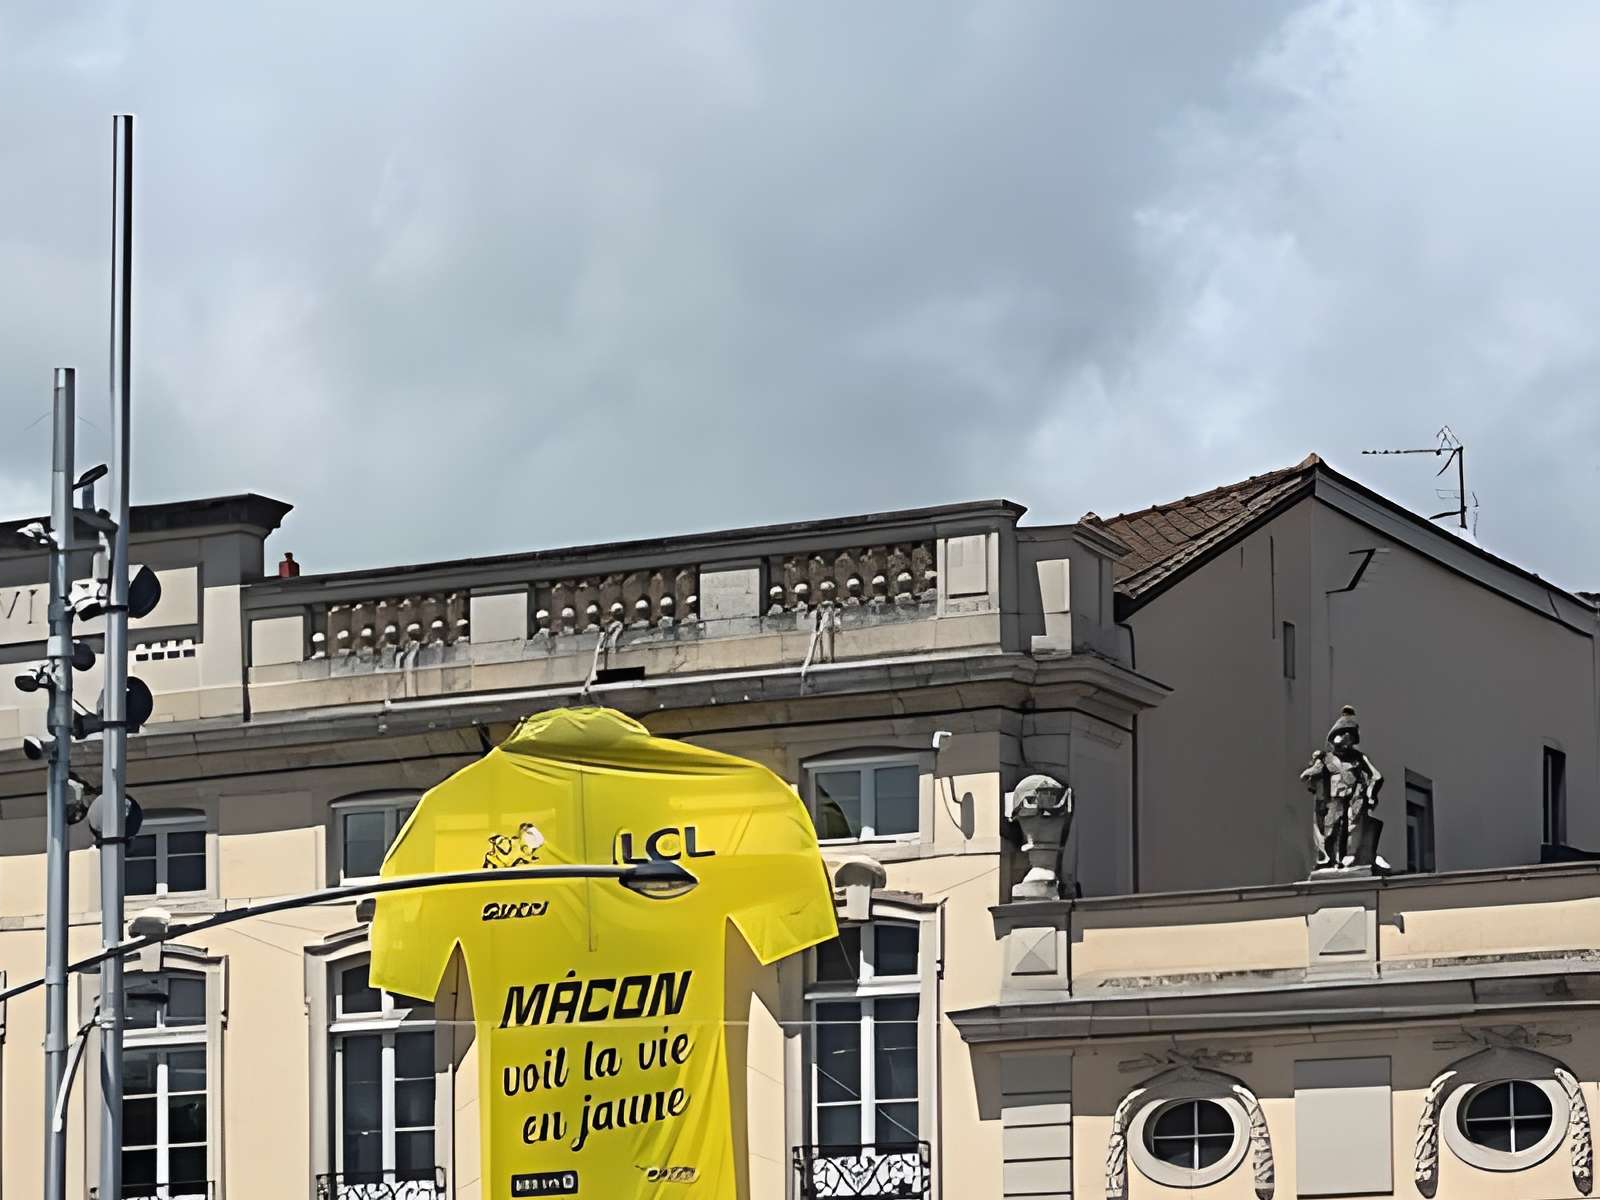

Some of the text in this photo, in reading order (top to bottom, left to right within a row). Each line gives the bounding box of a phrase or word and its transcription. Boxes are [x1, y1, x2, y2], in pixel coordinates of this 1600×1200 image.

[620, 826, 716, 865] LCL
[583, 1040, 622, 1081] la
[638, 1026, 695, 1071] vie
[522, 1087, 691, 1153] en jaune
